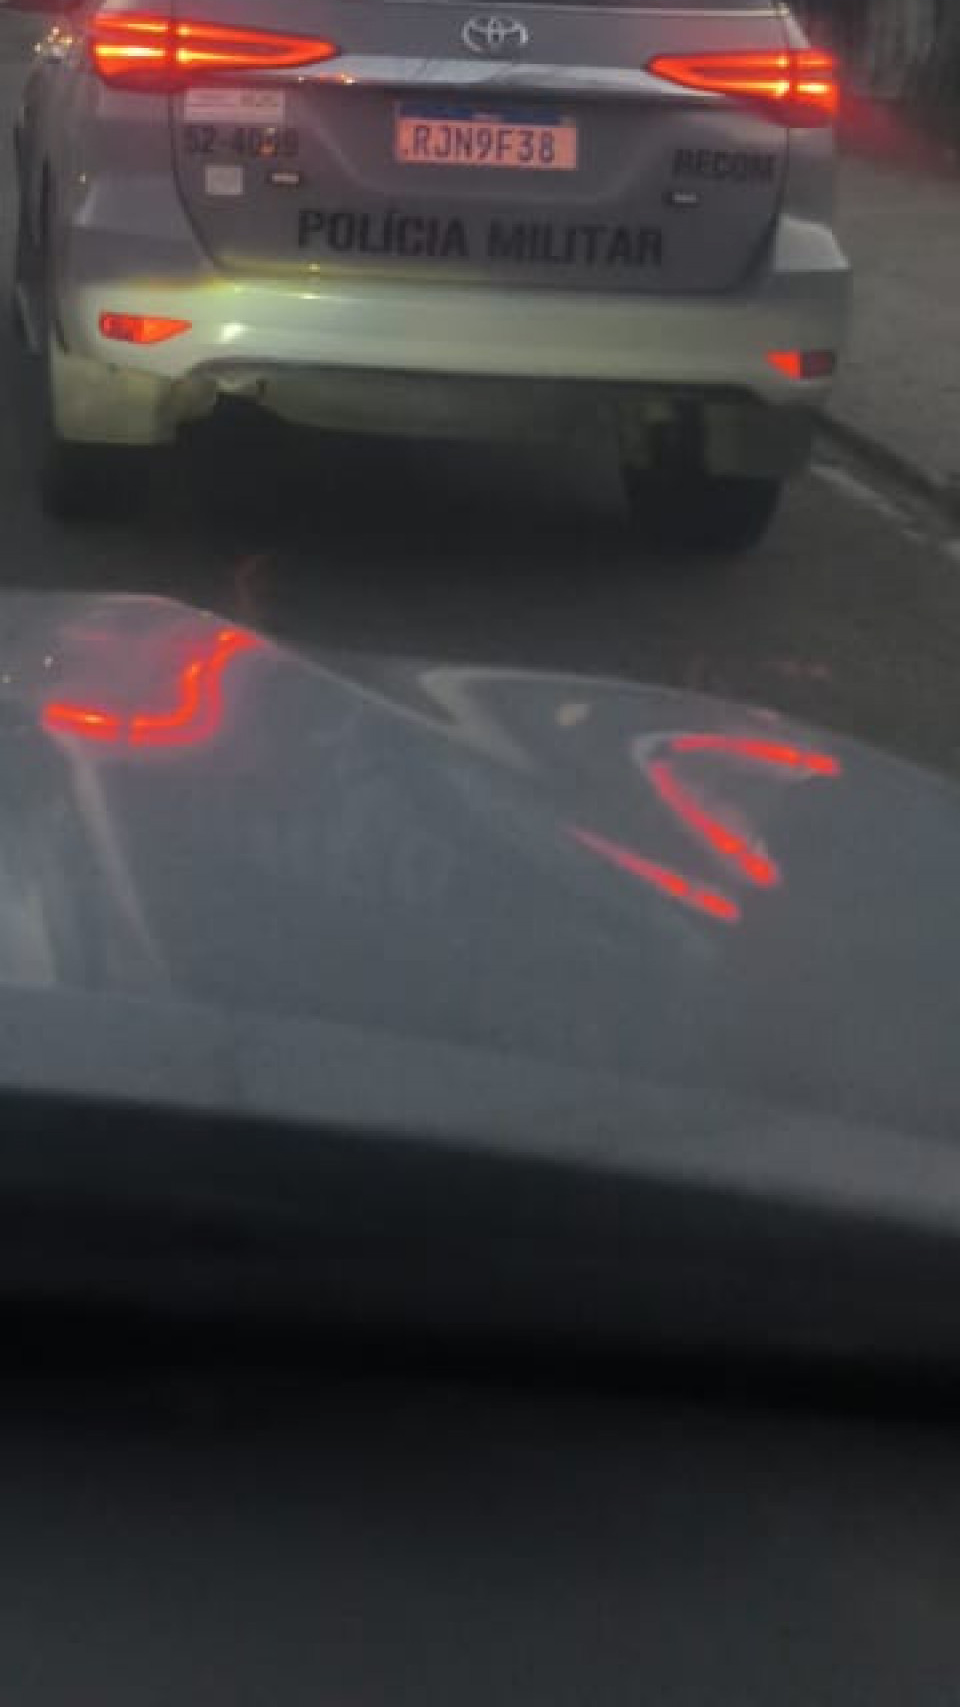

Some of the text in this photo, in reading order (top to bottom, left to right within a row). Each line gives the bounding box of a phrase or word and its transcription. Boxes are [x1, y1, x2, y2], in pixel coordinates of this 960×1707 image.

[413, 124, 555, 163] RJN9F38
[672, 148, 776, 183] RECOM
[297, 207, 663, 267] POLÍCIA MILITAR
